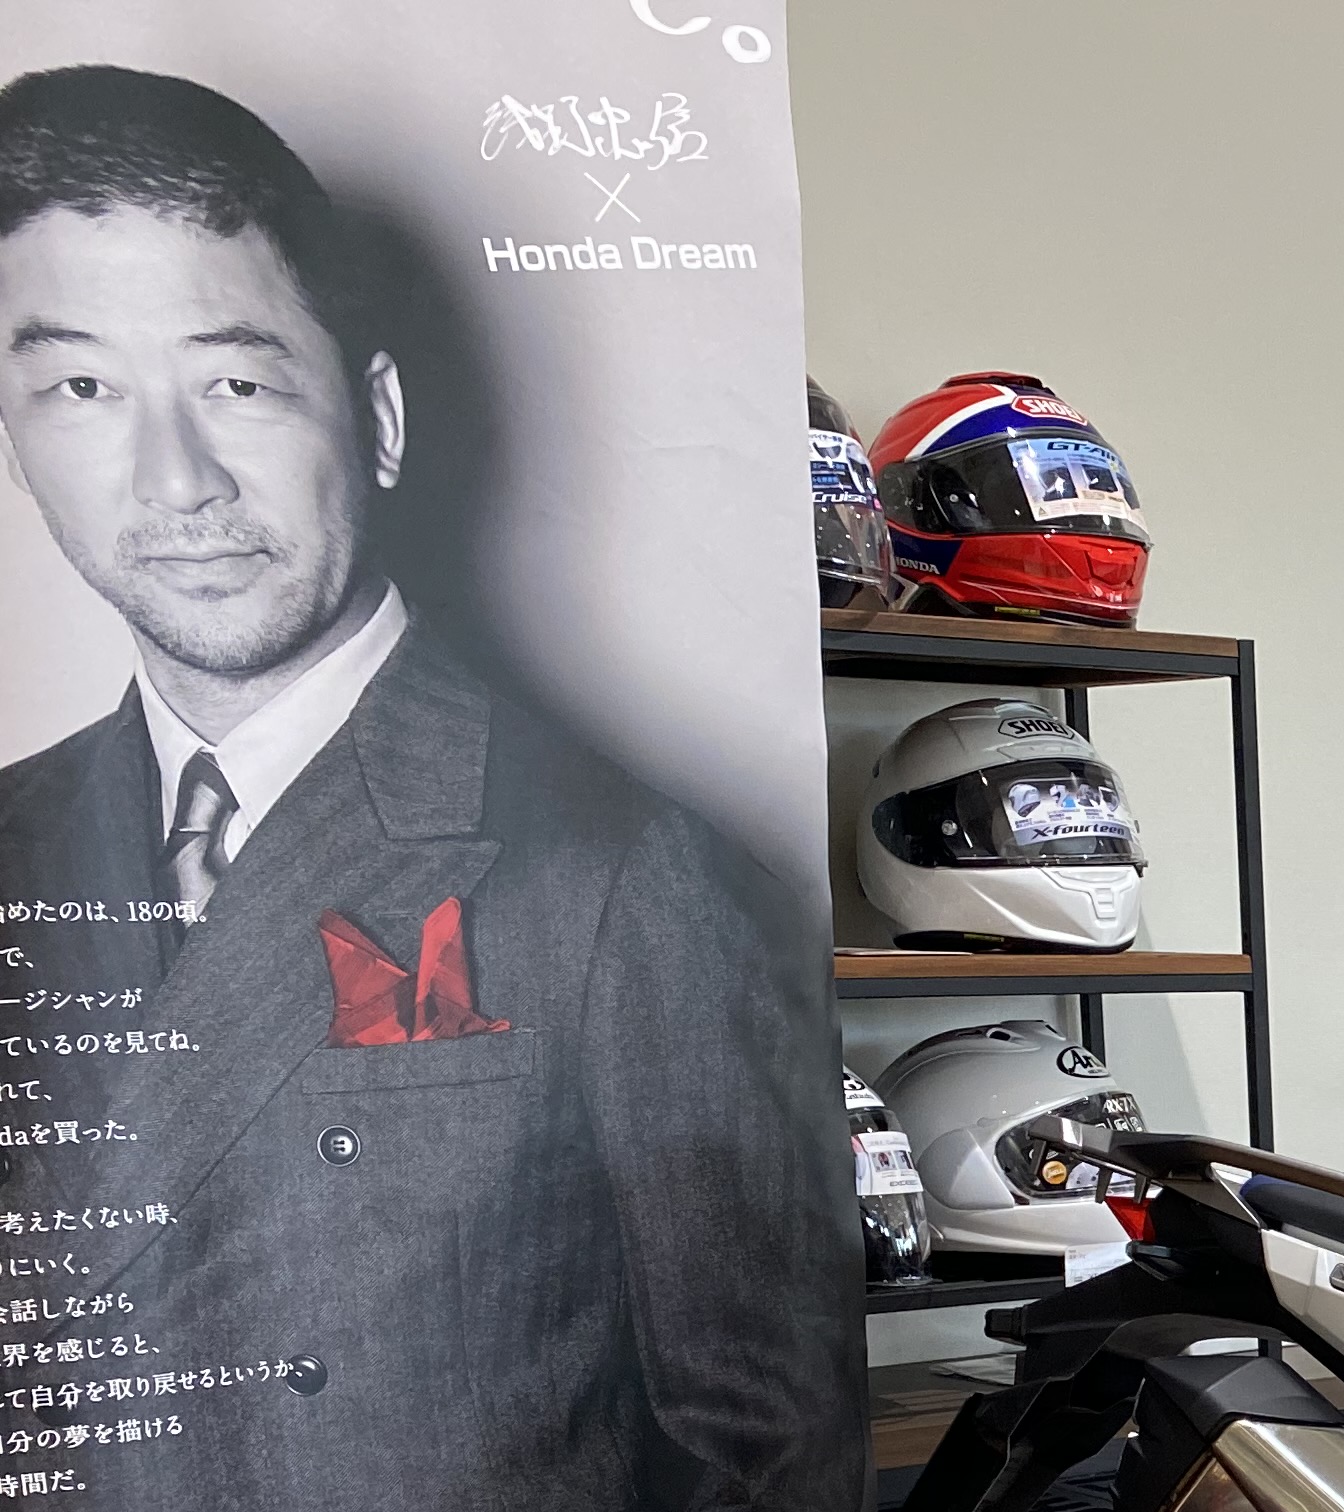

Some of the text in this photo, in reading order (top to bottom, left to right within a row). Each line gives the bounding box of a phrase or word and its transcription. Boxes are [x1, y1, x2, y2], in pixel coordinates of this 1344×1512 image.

[482, 235, 758, 271] Honda Dream
[1021, 398, 1085, 422] SHOEI
[1008, 718, 1068, 736] SHOEI
[0, 1028, 200, 1057] ているのを見てね。
[0, 1203, 179, 1235] 考えたくない時、
[0, 1252, 91, 1277] にいく。
[0, 1333, 160, 1368] 界を感じると、
[0, 1358, 304, 1409] て自分を取り戻せるというか、
[0, 1415, 184, 1455] 分の夢を描ける
